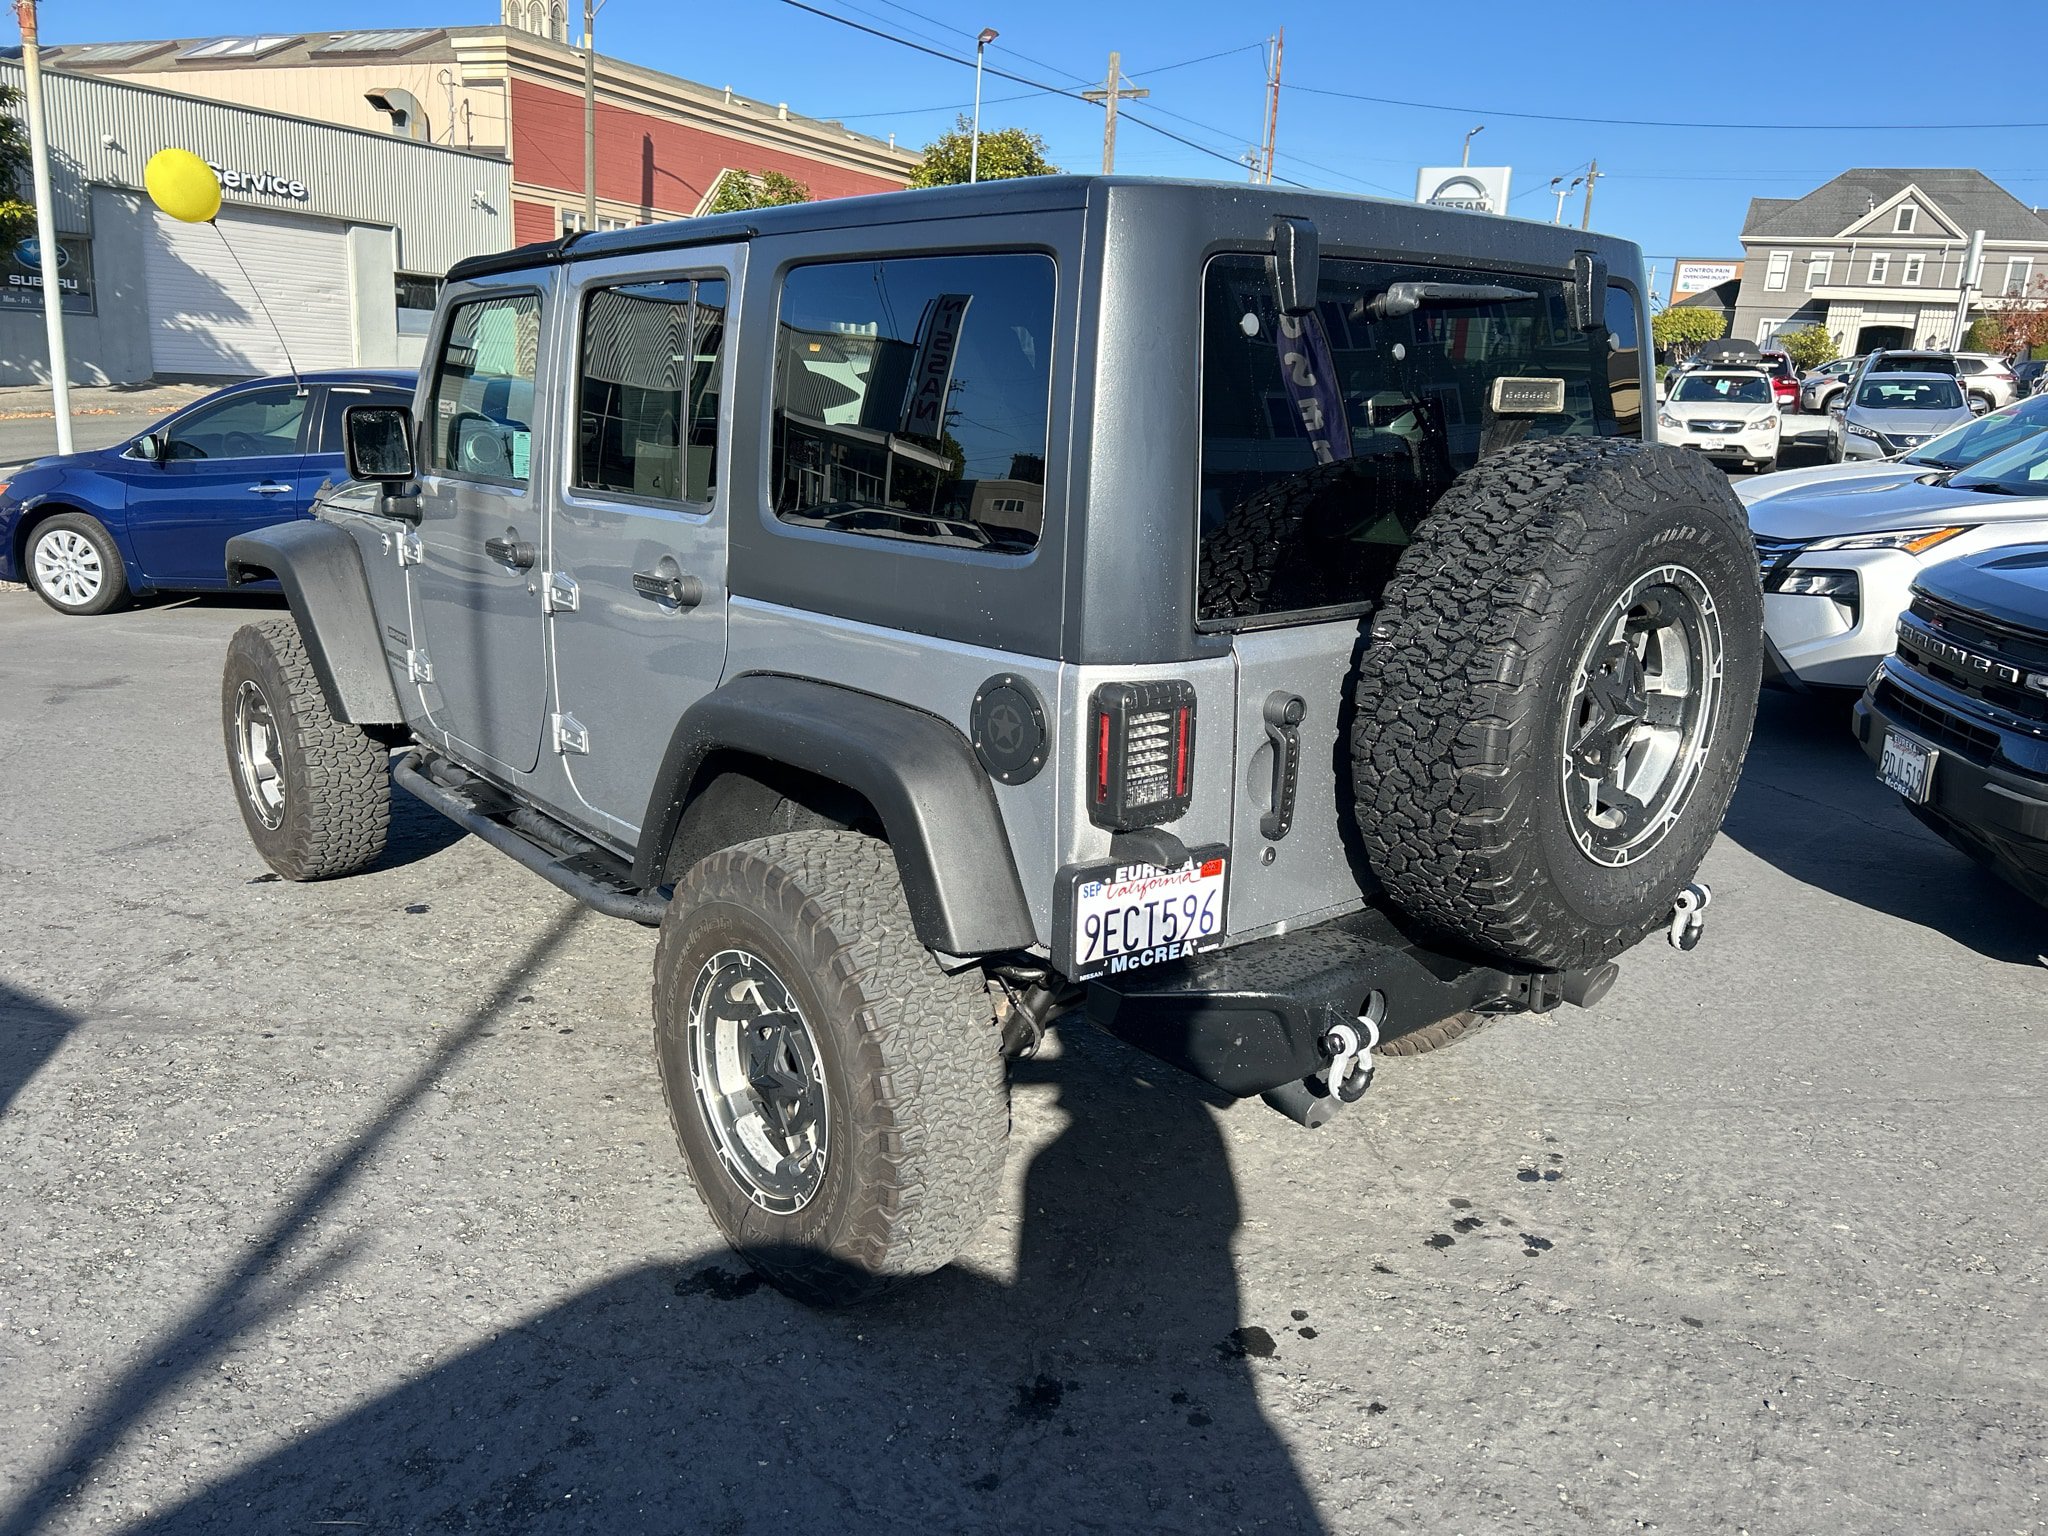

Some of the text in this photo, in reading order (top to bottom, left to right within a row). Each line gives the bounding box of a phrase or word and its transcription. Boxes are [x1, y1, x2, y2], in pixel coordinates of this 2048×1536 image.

[206, 160, 305, 197] Service
[8, 274, 78, 290] SUBRU
[1902, 624, 2019, 684] BRONCO
[1894, 734, 1917, 752] EUREKA
[1881, 750, 1923, 792] 9DJL519
[1884, 776, 1909, 798] McCREA
[1083, 871, 1201, 901] SEP California
[1115, 856, 1194, 884] EURA
[1084, 889, 1217, 962] 9ECT596
[1079, 970, 1104, 982] NISSAN
[1111, 942, 1194, 975] McCREA
